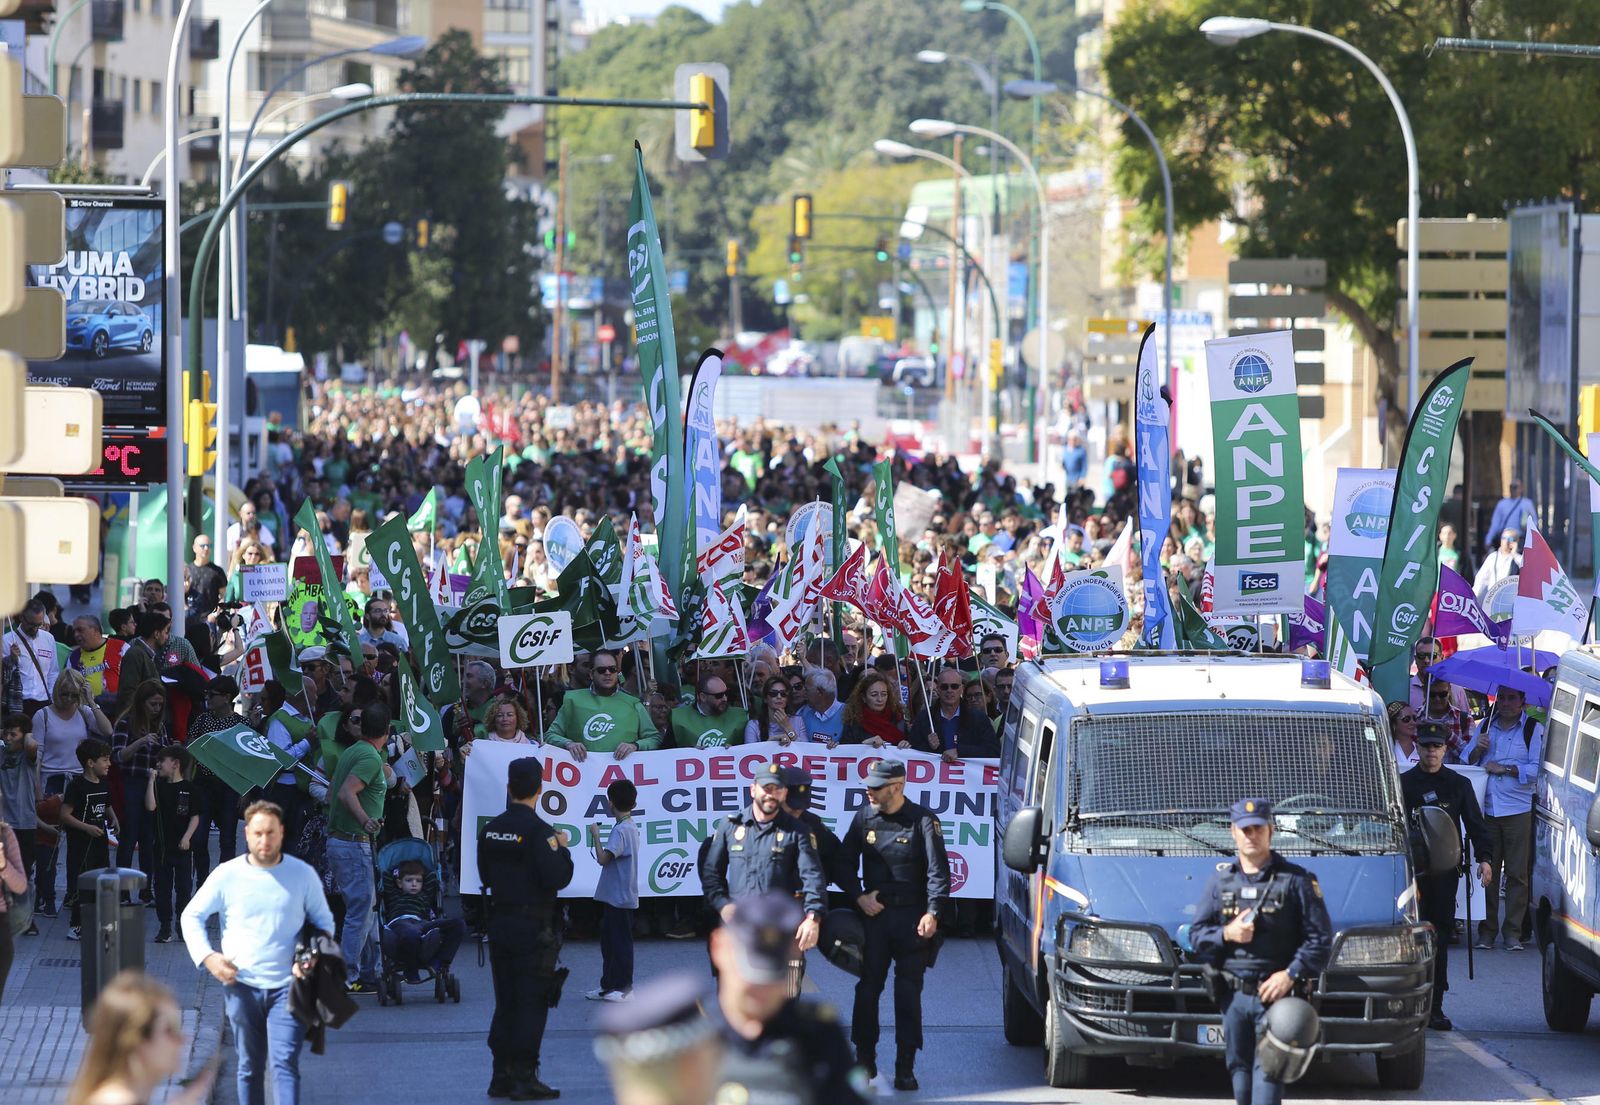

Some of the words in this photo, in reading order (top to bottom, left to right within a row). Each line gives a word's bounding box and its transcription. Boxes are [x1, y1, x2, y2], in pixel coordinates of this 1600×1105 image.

[91, 378, 121, 391] Ford
[1239, 376, 1269, 387] ANPE
[1226, 403, 1289, 560] ANPE
[1244, 576, 1277, 589] fses
[1056, 580, 1082, 605] SINDICATO
[1083, 578, 1126, 606] INDEPENDIENTE
[1066, 617, 1114, 632] ANPE
[1070, 640, 1113, 651] ANDALUCÍA
[702, 737, 727, 748] CSIF
[598, 764, 659, 788] AL
[906, 759, 966, 785] DE
[485, 831, 519, 841] POLICIA
[657, 862, 695, 878] CSIF
